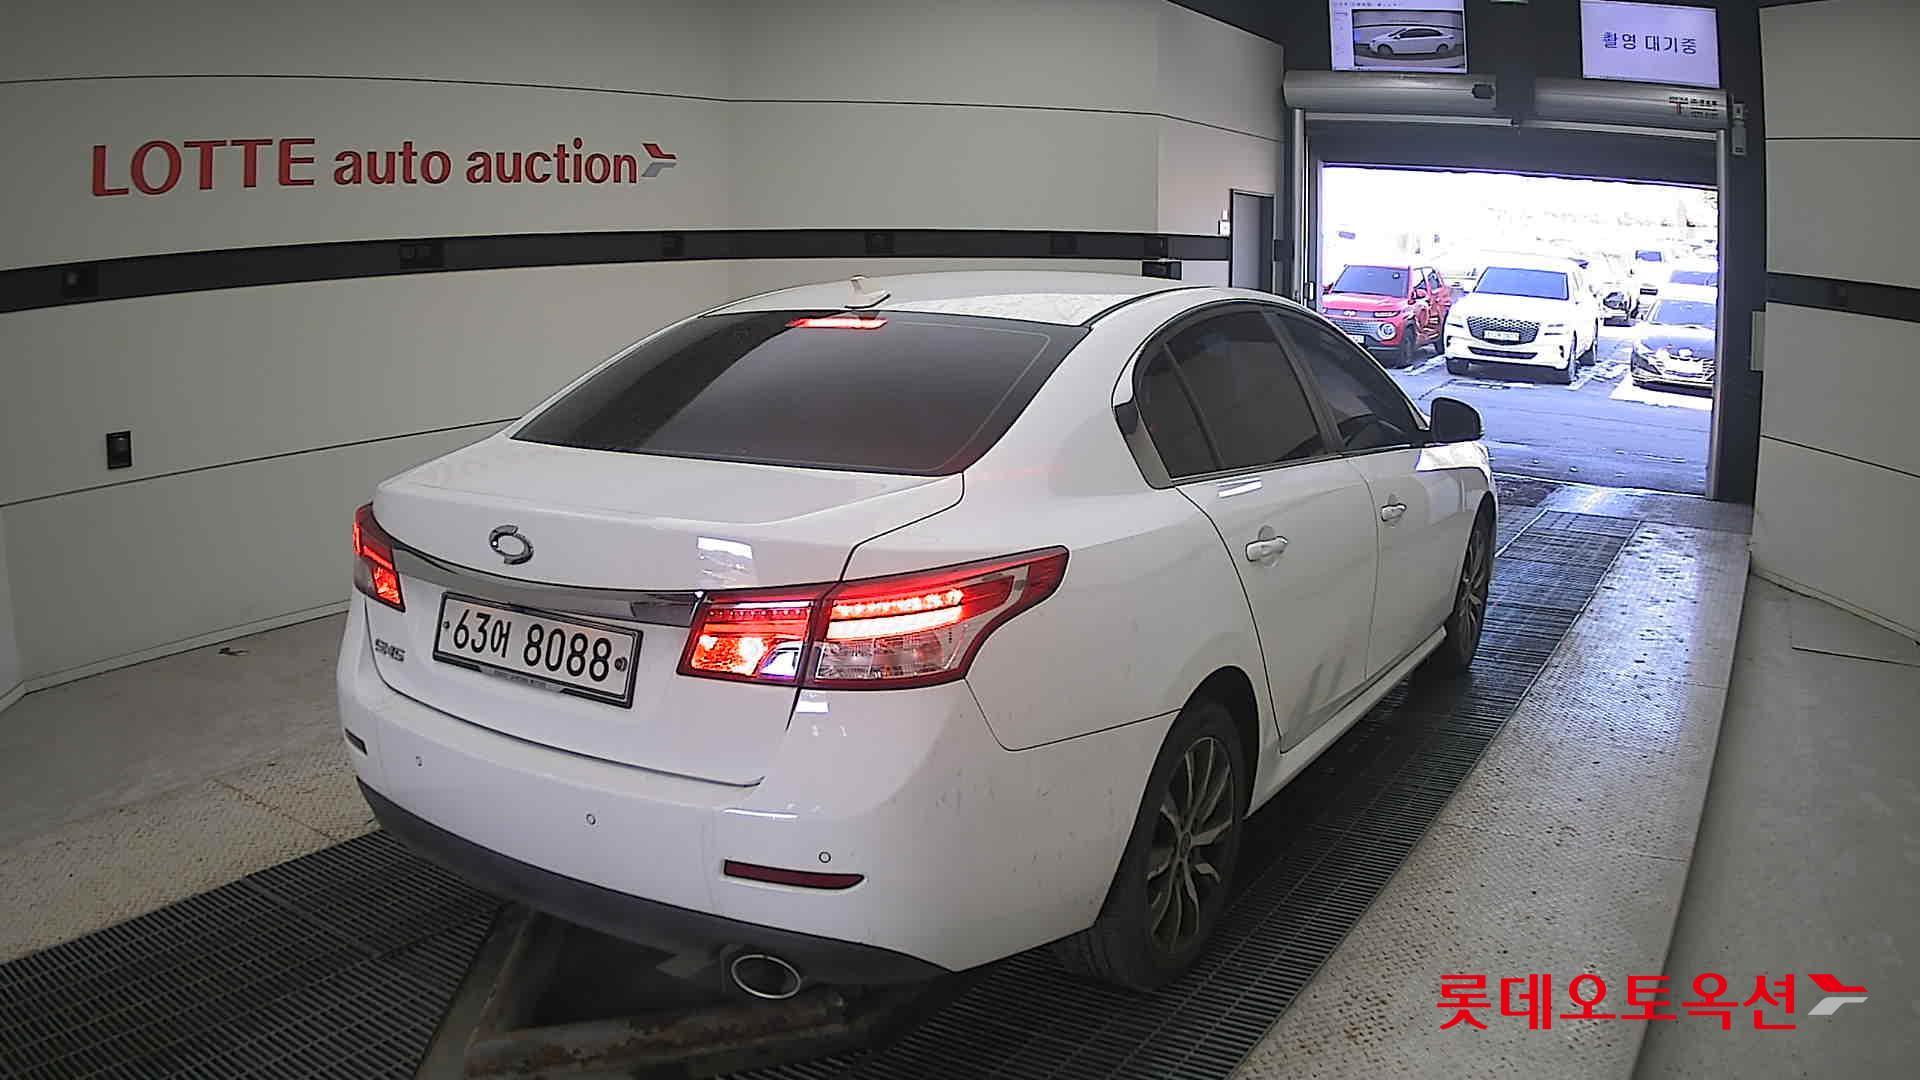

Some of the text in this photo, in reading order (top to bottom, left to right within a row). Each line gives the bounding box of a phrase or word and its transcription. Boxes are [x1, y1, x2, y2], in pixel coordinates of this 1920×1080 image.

[1644, 35, 1697, 55] 대기중
[91, 137, 638, 197] LOTTE auto auction
[453, 609, 512, 659] 63어
[522, 623, 613, 683] 8088
